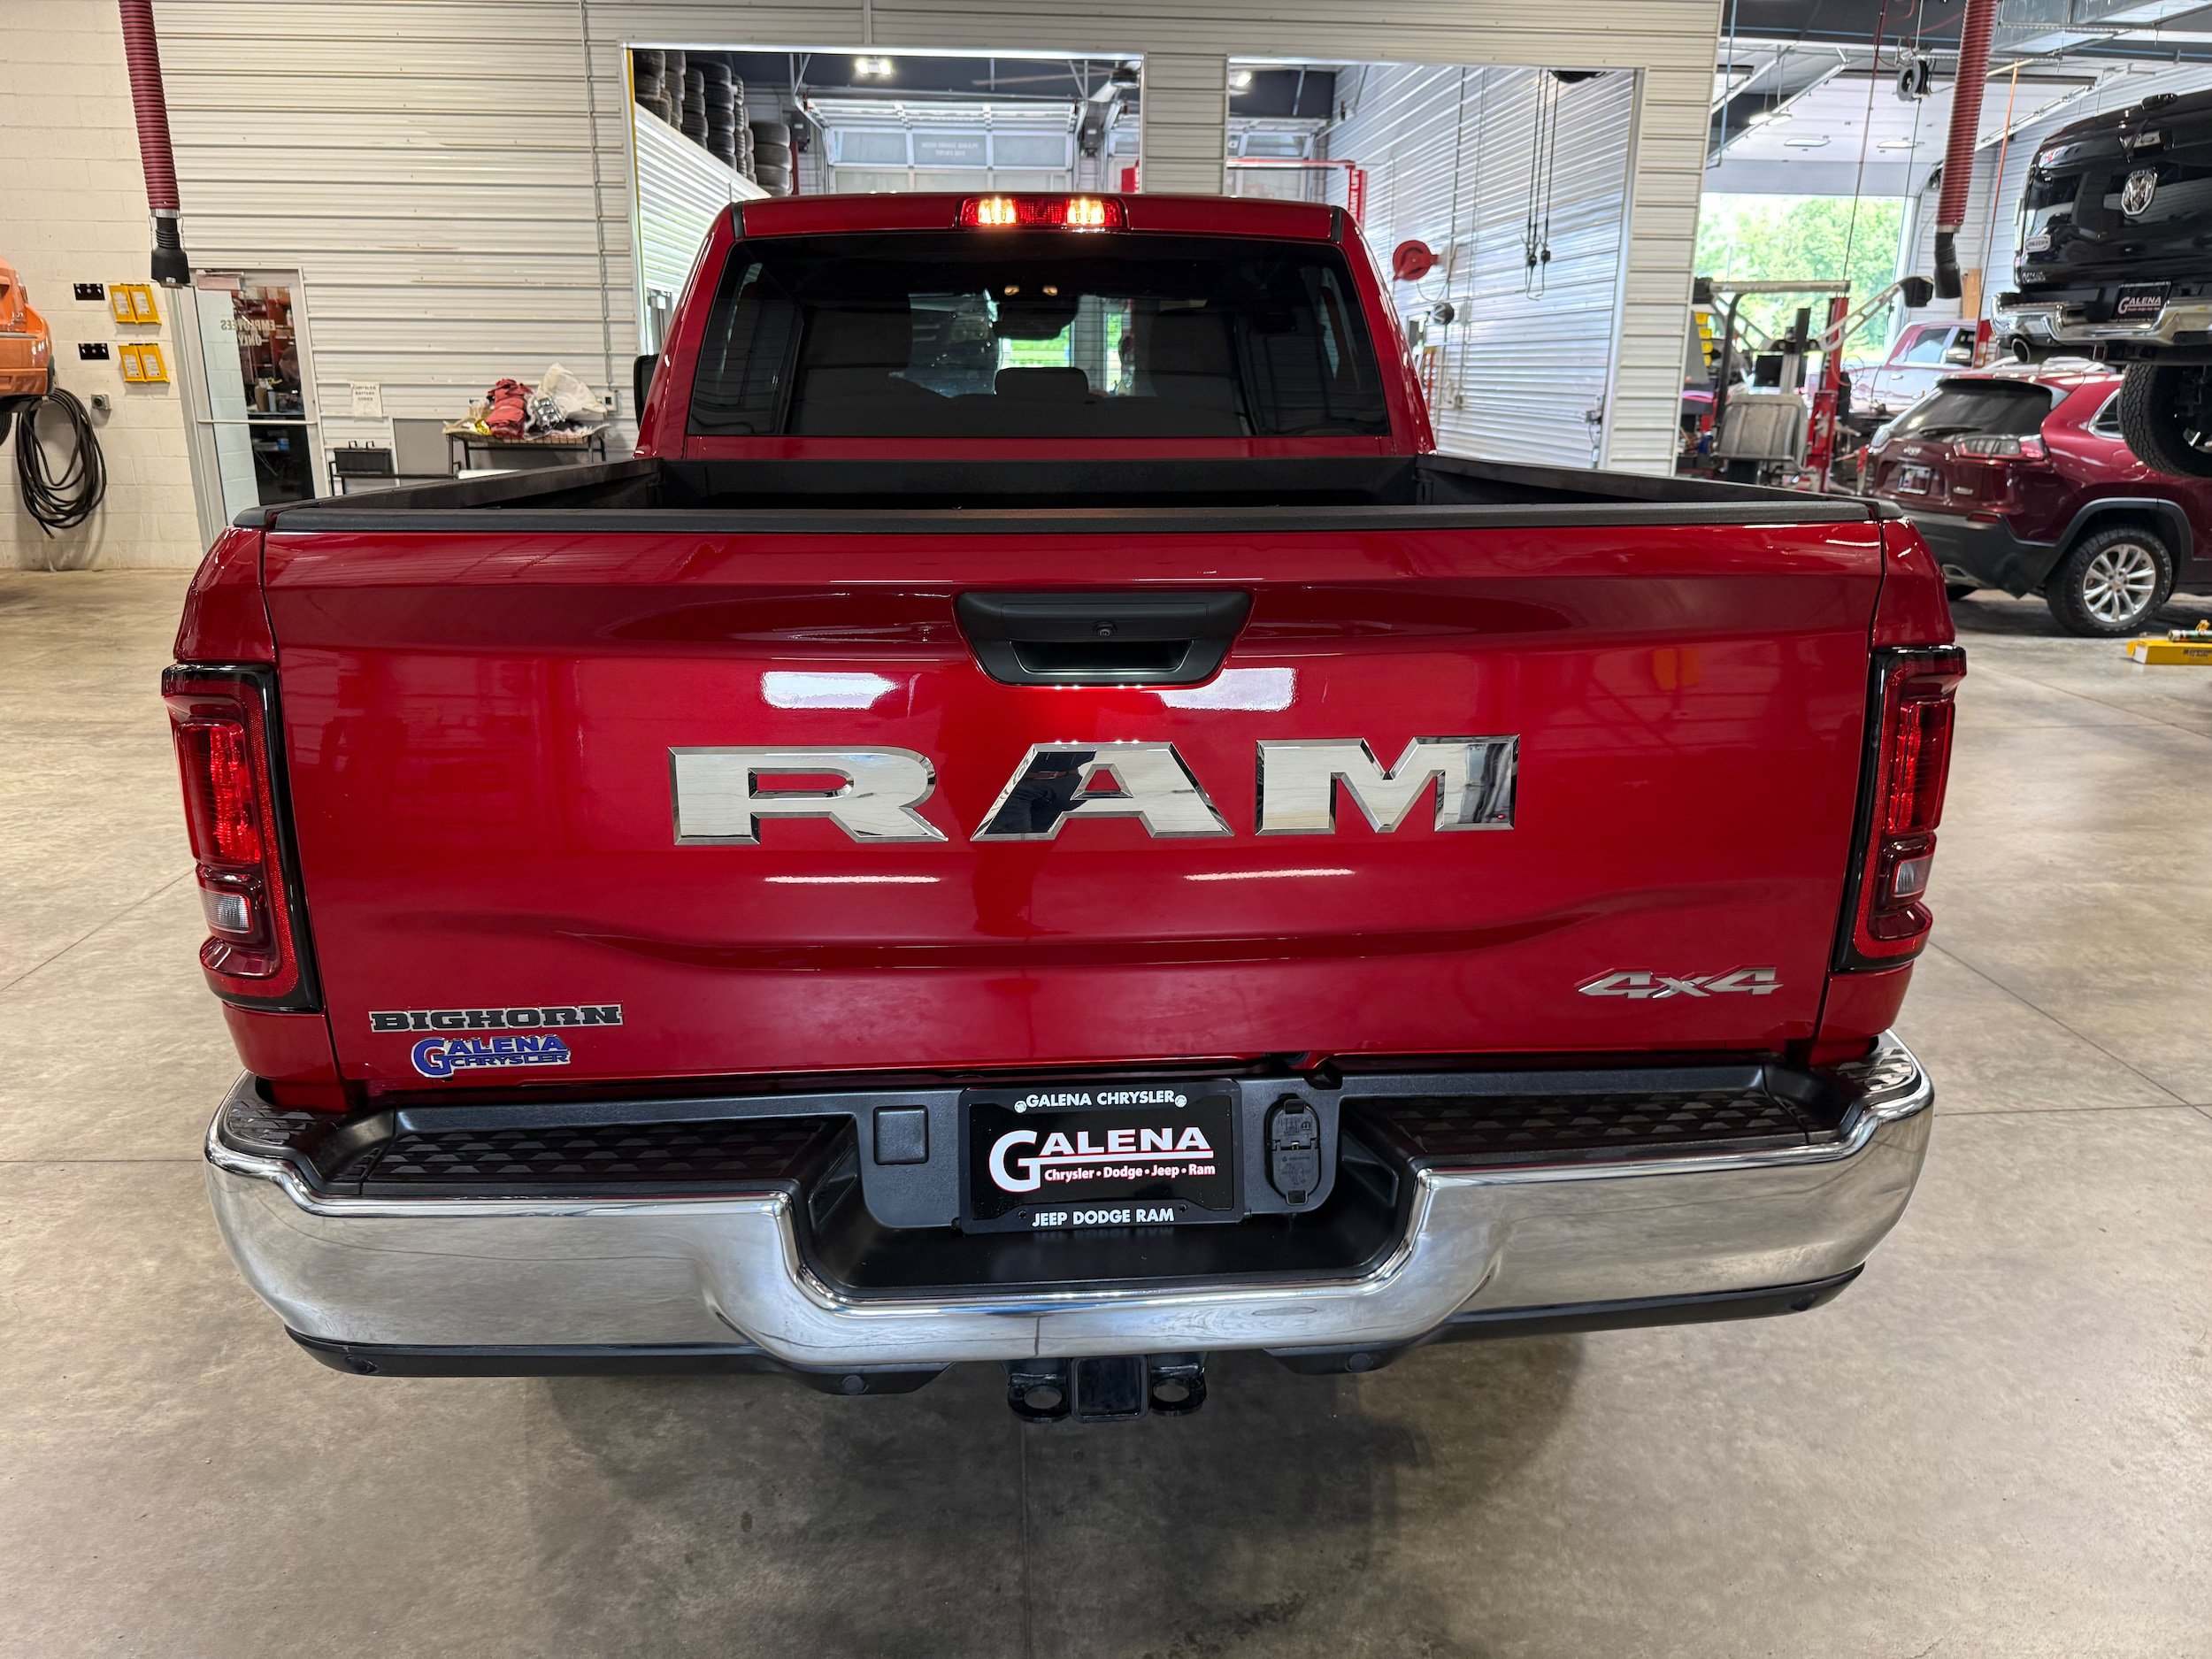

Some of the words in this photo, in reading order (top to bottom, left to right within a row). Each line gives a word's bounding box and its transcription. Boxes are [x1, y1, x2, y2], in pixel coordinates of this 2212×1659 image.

[2117, 296, 2162, 314] GALENA
[668, 733, 1521, 847] RAM
[1574, 965, 1785, 1000] 4x4
[368, 1004, 623, 1033] BIGHORN
[411, 1033, 569, 1078] GALENA
[449, 1053, 568, 1067] CHRYSLER
[1025, 1092, 1092, 1108] GALENA
[1096, 1089, 1175, 1106] CHRYSLER
[988, 1126, 1214, 1193] GALENA
[1044, 1167, 1095, 1182] Chrysler
[1102, 1165, 1143, 1179] Dodge
[1150, 1164, 1179, 1179] Jeep
[1188, 1164, 1216, 1176] Ram
[1032, 1211, 1068, 1227] JEEP
[1072, 1209, 1131, 1225] DODGE
[1135, 1208, 1174, 1223] RAM
